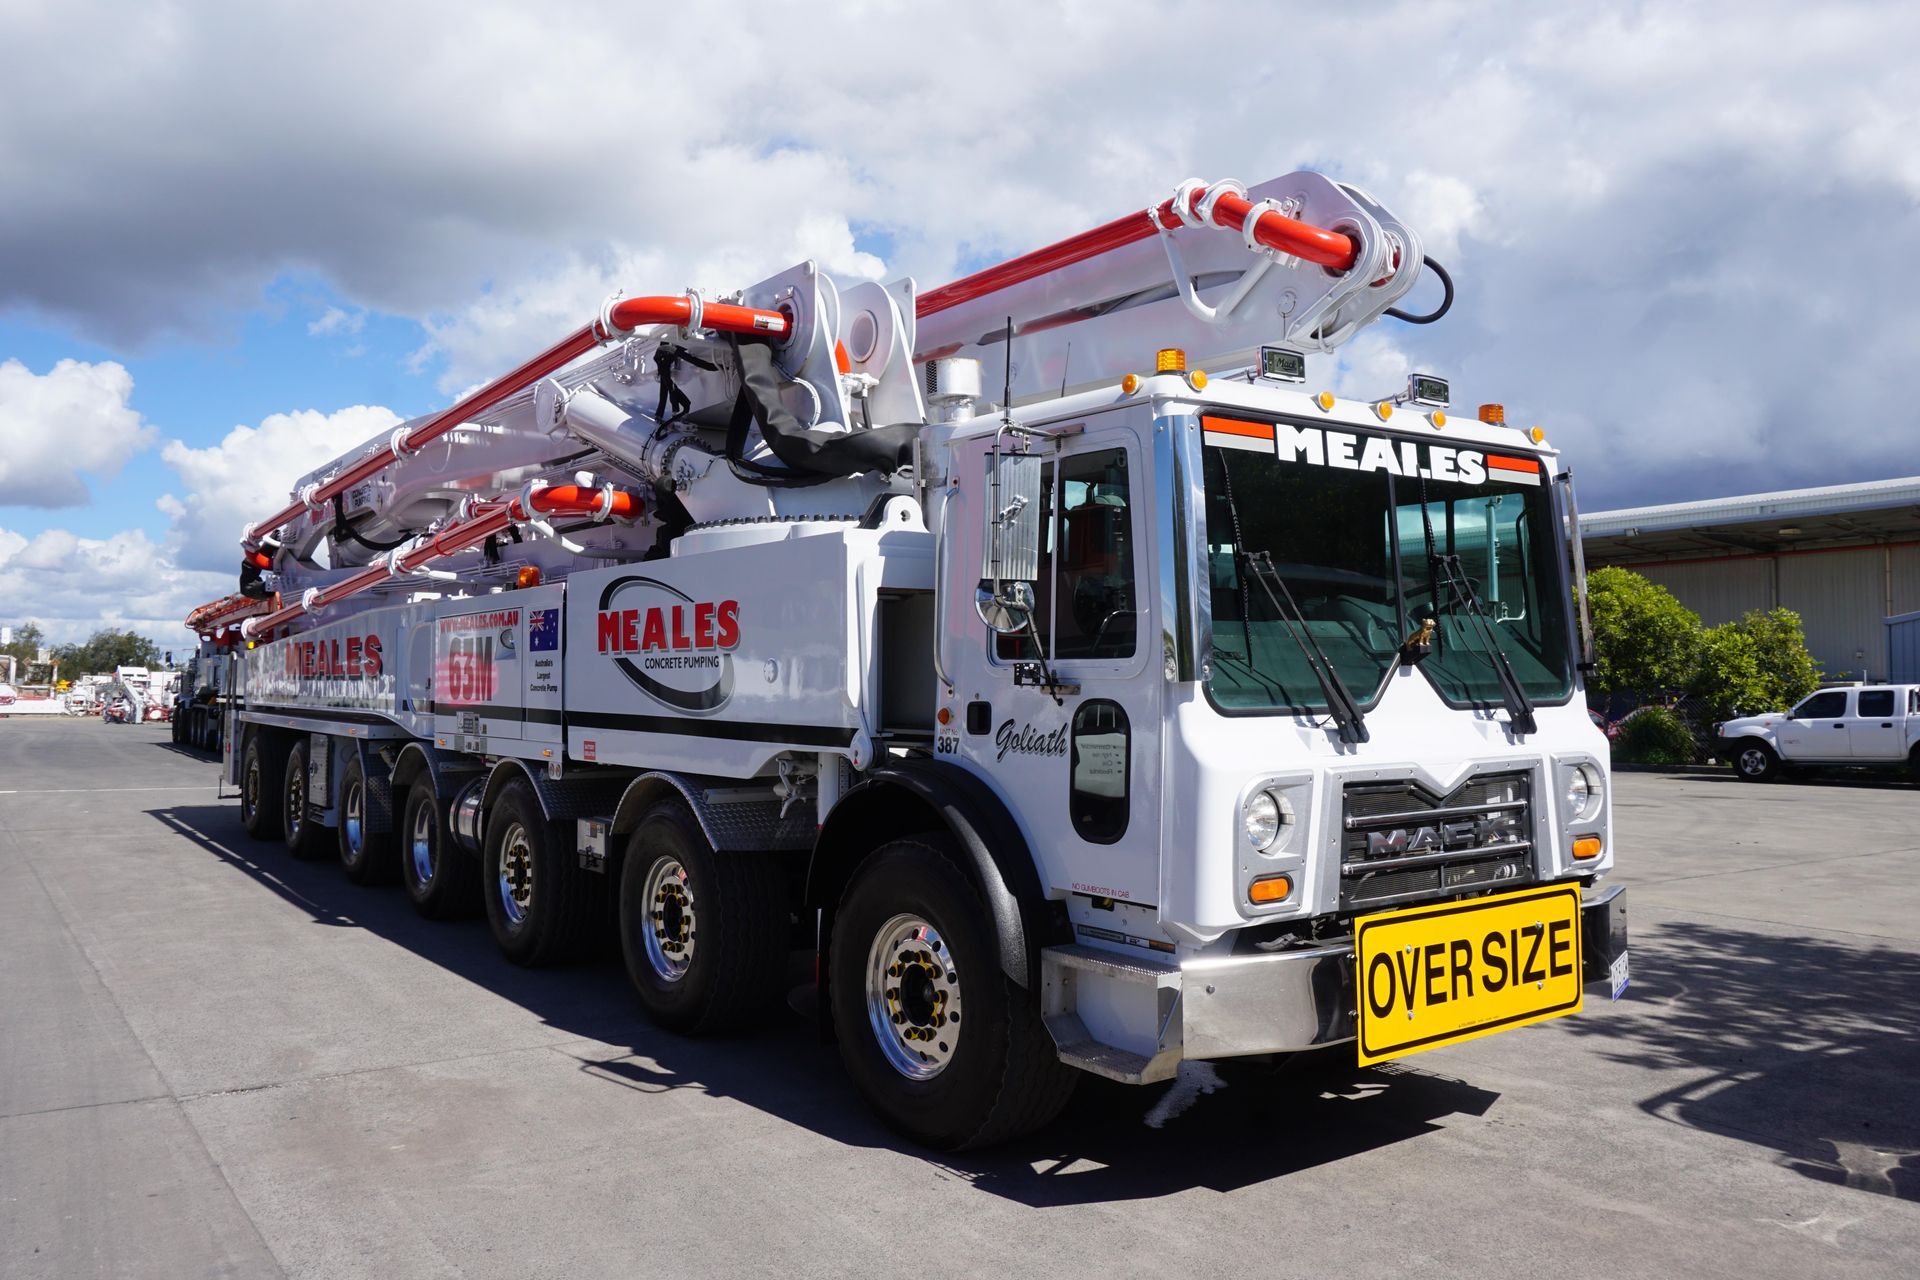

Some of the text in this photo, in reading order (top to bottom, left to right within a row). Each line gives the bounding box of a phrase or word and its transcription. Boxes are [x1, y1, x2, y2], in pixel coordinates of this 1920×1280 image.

[1276, 357, 1297, 371] Mack
[1275, 423, 1487, 485] MEALES
[597, 599, 741, 655] MEALES
[285, 634, 383, 680] MEALES
[448, 636, 493, 701] 63M
[644, 655, 720, 670] CONCRETE PUMPING
[937, 735, 960, 755] 387
[996, 718, 1069, 762] Goliath
[1080, 884, 1111, 896] GUMBOOTS
[1117, 890, 1130, 899] CAB
[1367, 918, 1573, 1019] OVERSIZE
